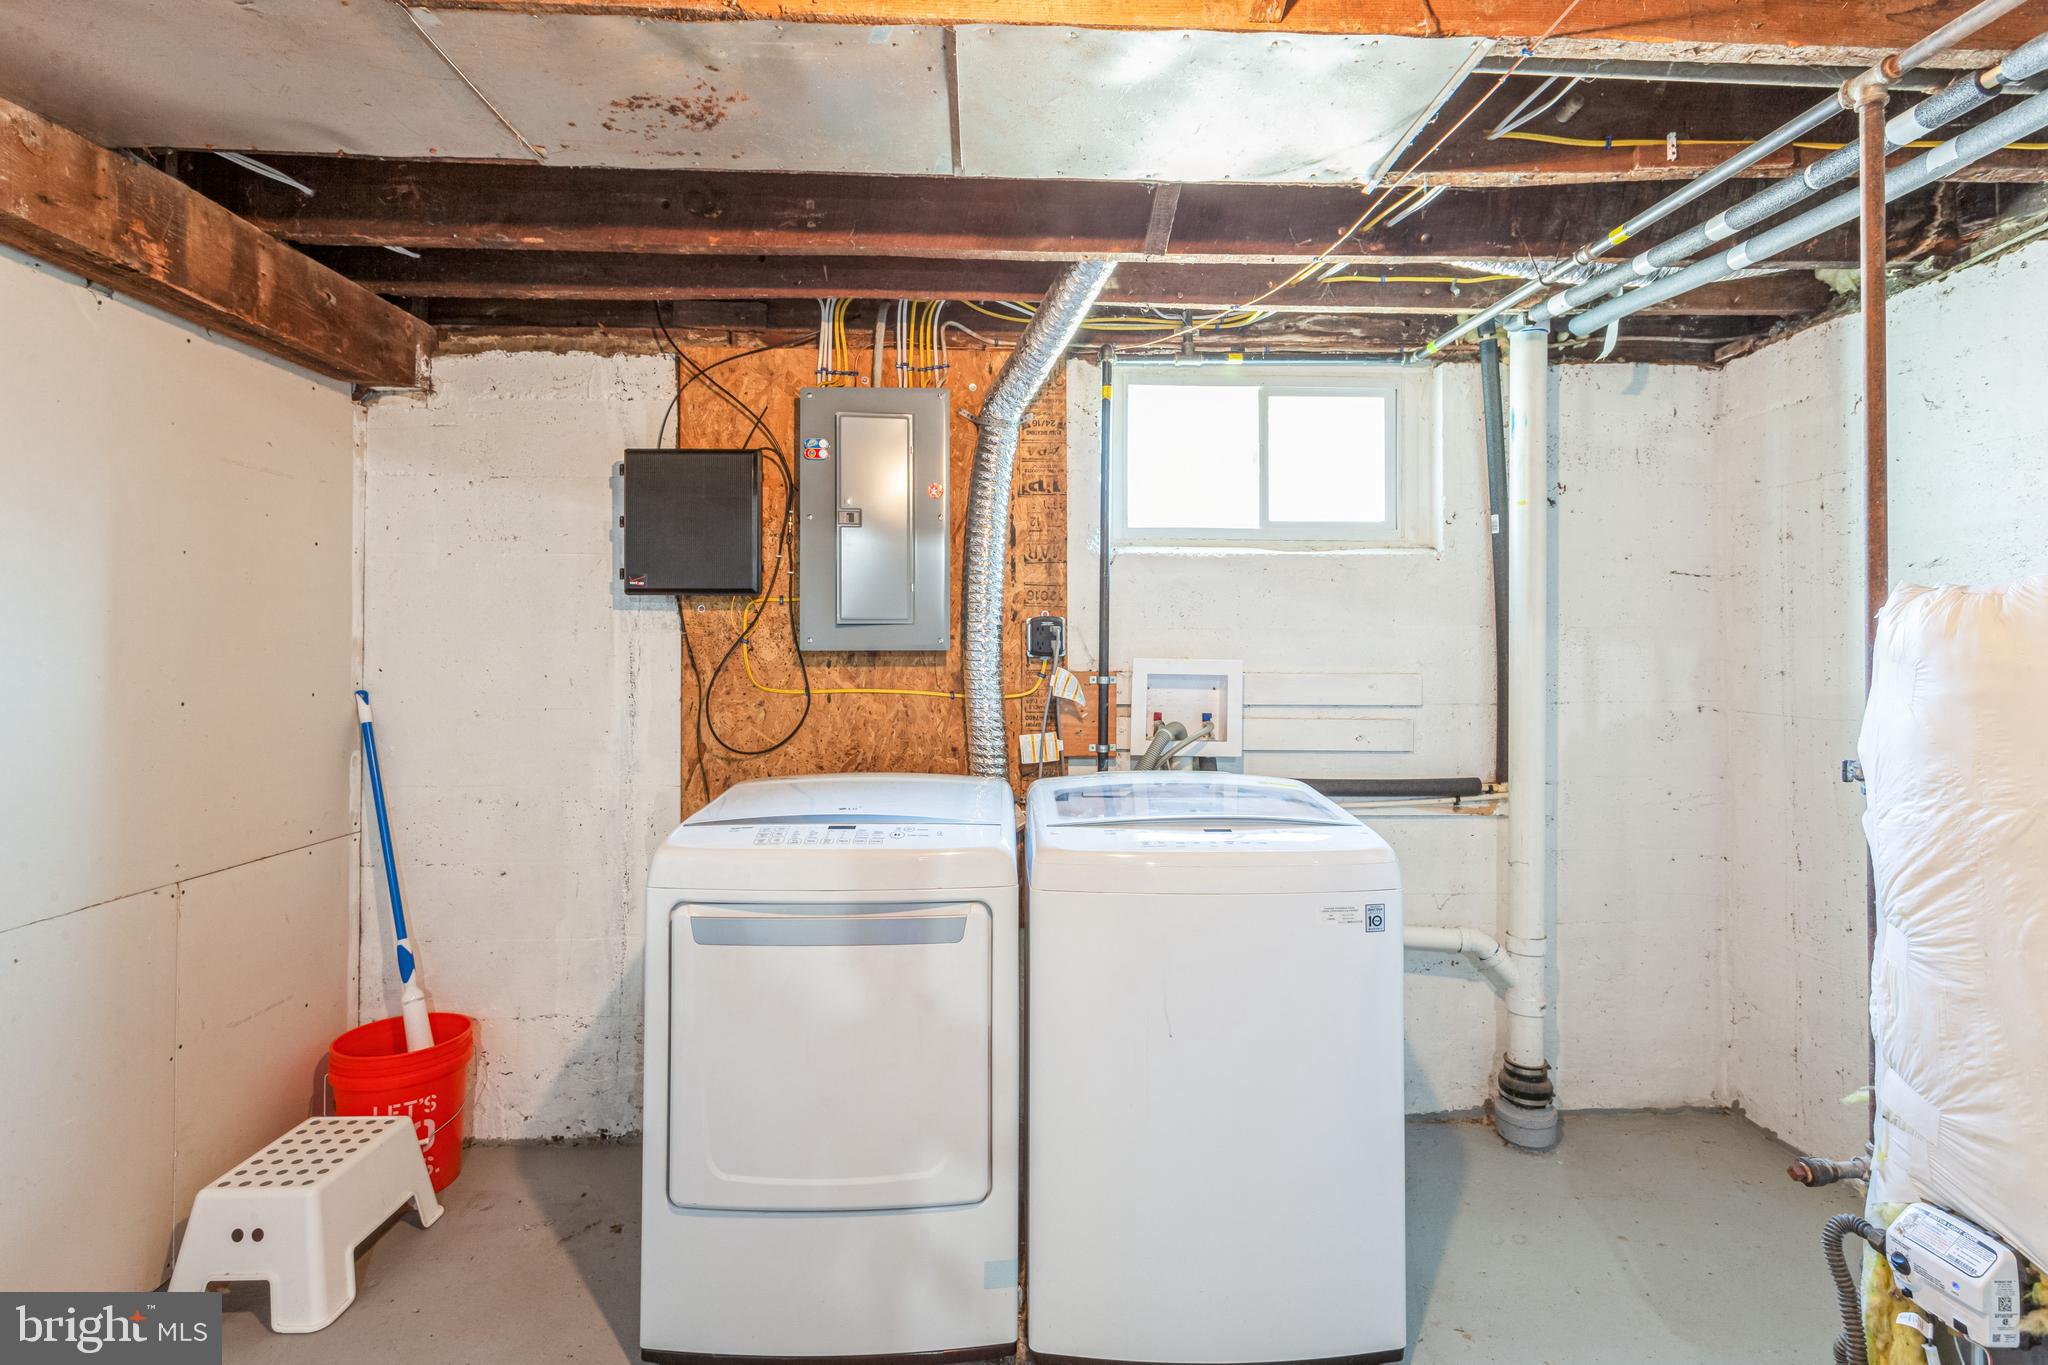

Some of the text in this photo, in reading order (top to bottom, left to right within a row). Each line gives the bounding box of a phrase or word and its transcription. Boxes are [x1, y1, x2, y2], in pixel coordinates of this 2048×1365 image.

[1032, 419, 1056, 428] 24/16
[1026, 589, 1057, 601] 2016
[1368, 915, 1383, 927] 10
